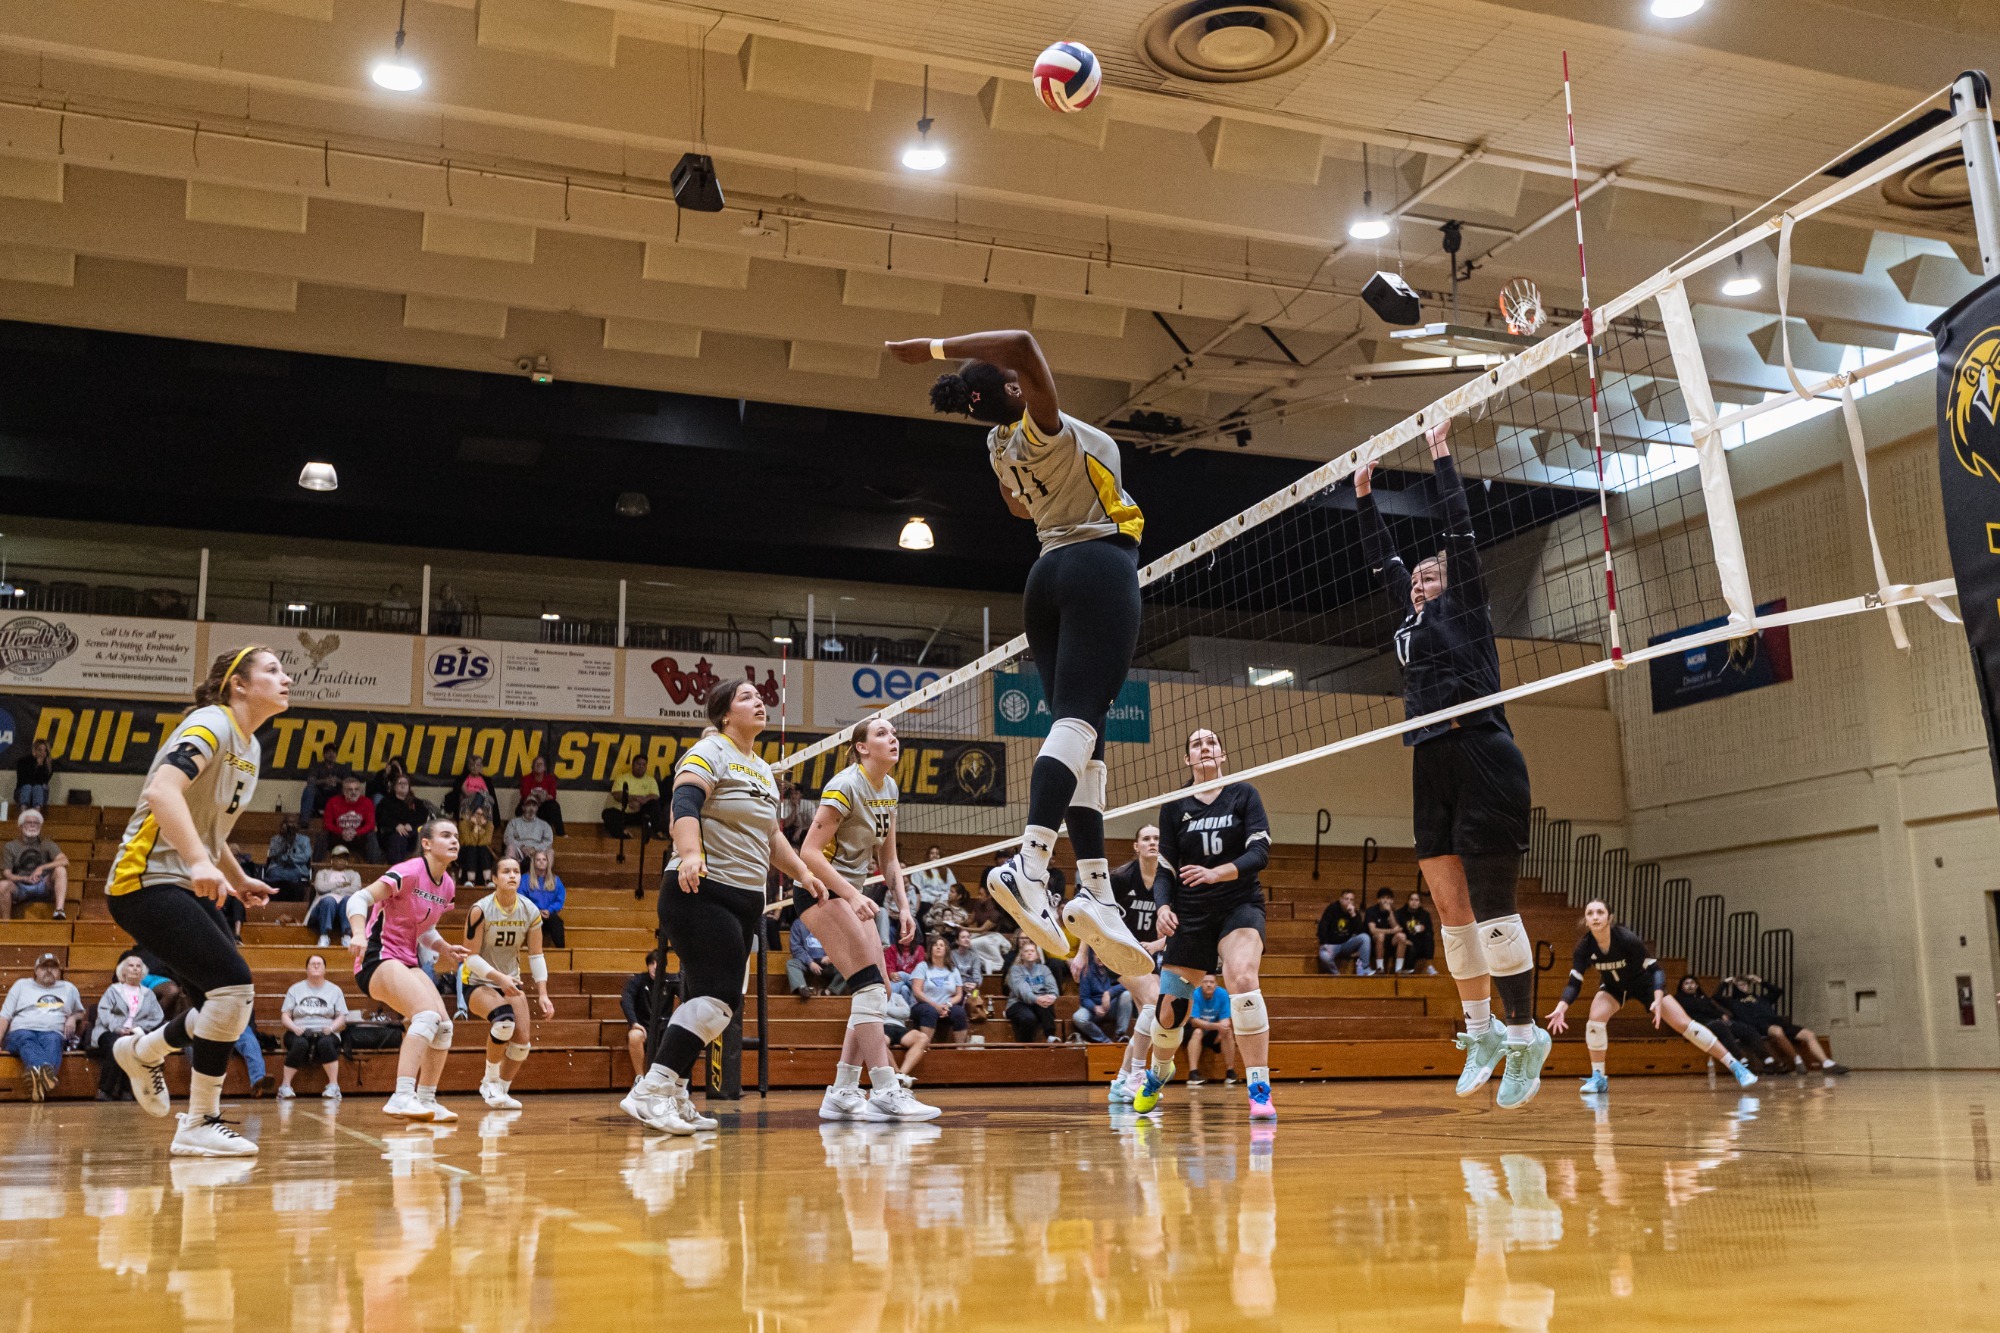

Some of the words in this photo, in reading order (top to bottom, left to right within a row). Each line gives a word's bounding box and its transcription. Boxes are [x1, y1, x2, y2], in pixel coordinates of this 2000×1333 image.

[101, 627, 118, 637] Call
[119, 629, 130, 638] Us
[146, 630, 157, 639] all
[158, 633, 176, 642] your
[85, 639, 109, 649] Screen
[146, 642, 190, 655] Embroidery
[105, 652, 118, 661] Ad
[119, 652, 154, 664] Specialty
[156, 655, 177, 664] Needs
[304, 667, 377, 687] Tradition
[317, 687, 341, 701] Club
[659, 708, 691, 718] Famous
[1106, 704, 1145, 721] ealth
[272, 718, 543, 778] TRADITION
[728, 762, 772, 789] PFEIFFER
[1187, 814, 1233, 833] BRUINS
[1201, 830, 1223, 856] 16
[1137, 911, 1153, 931] 15
[495, 931, 516, 947] 20
[1611, 969, 1620, 982] 1
